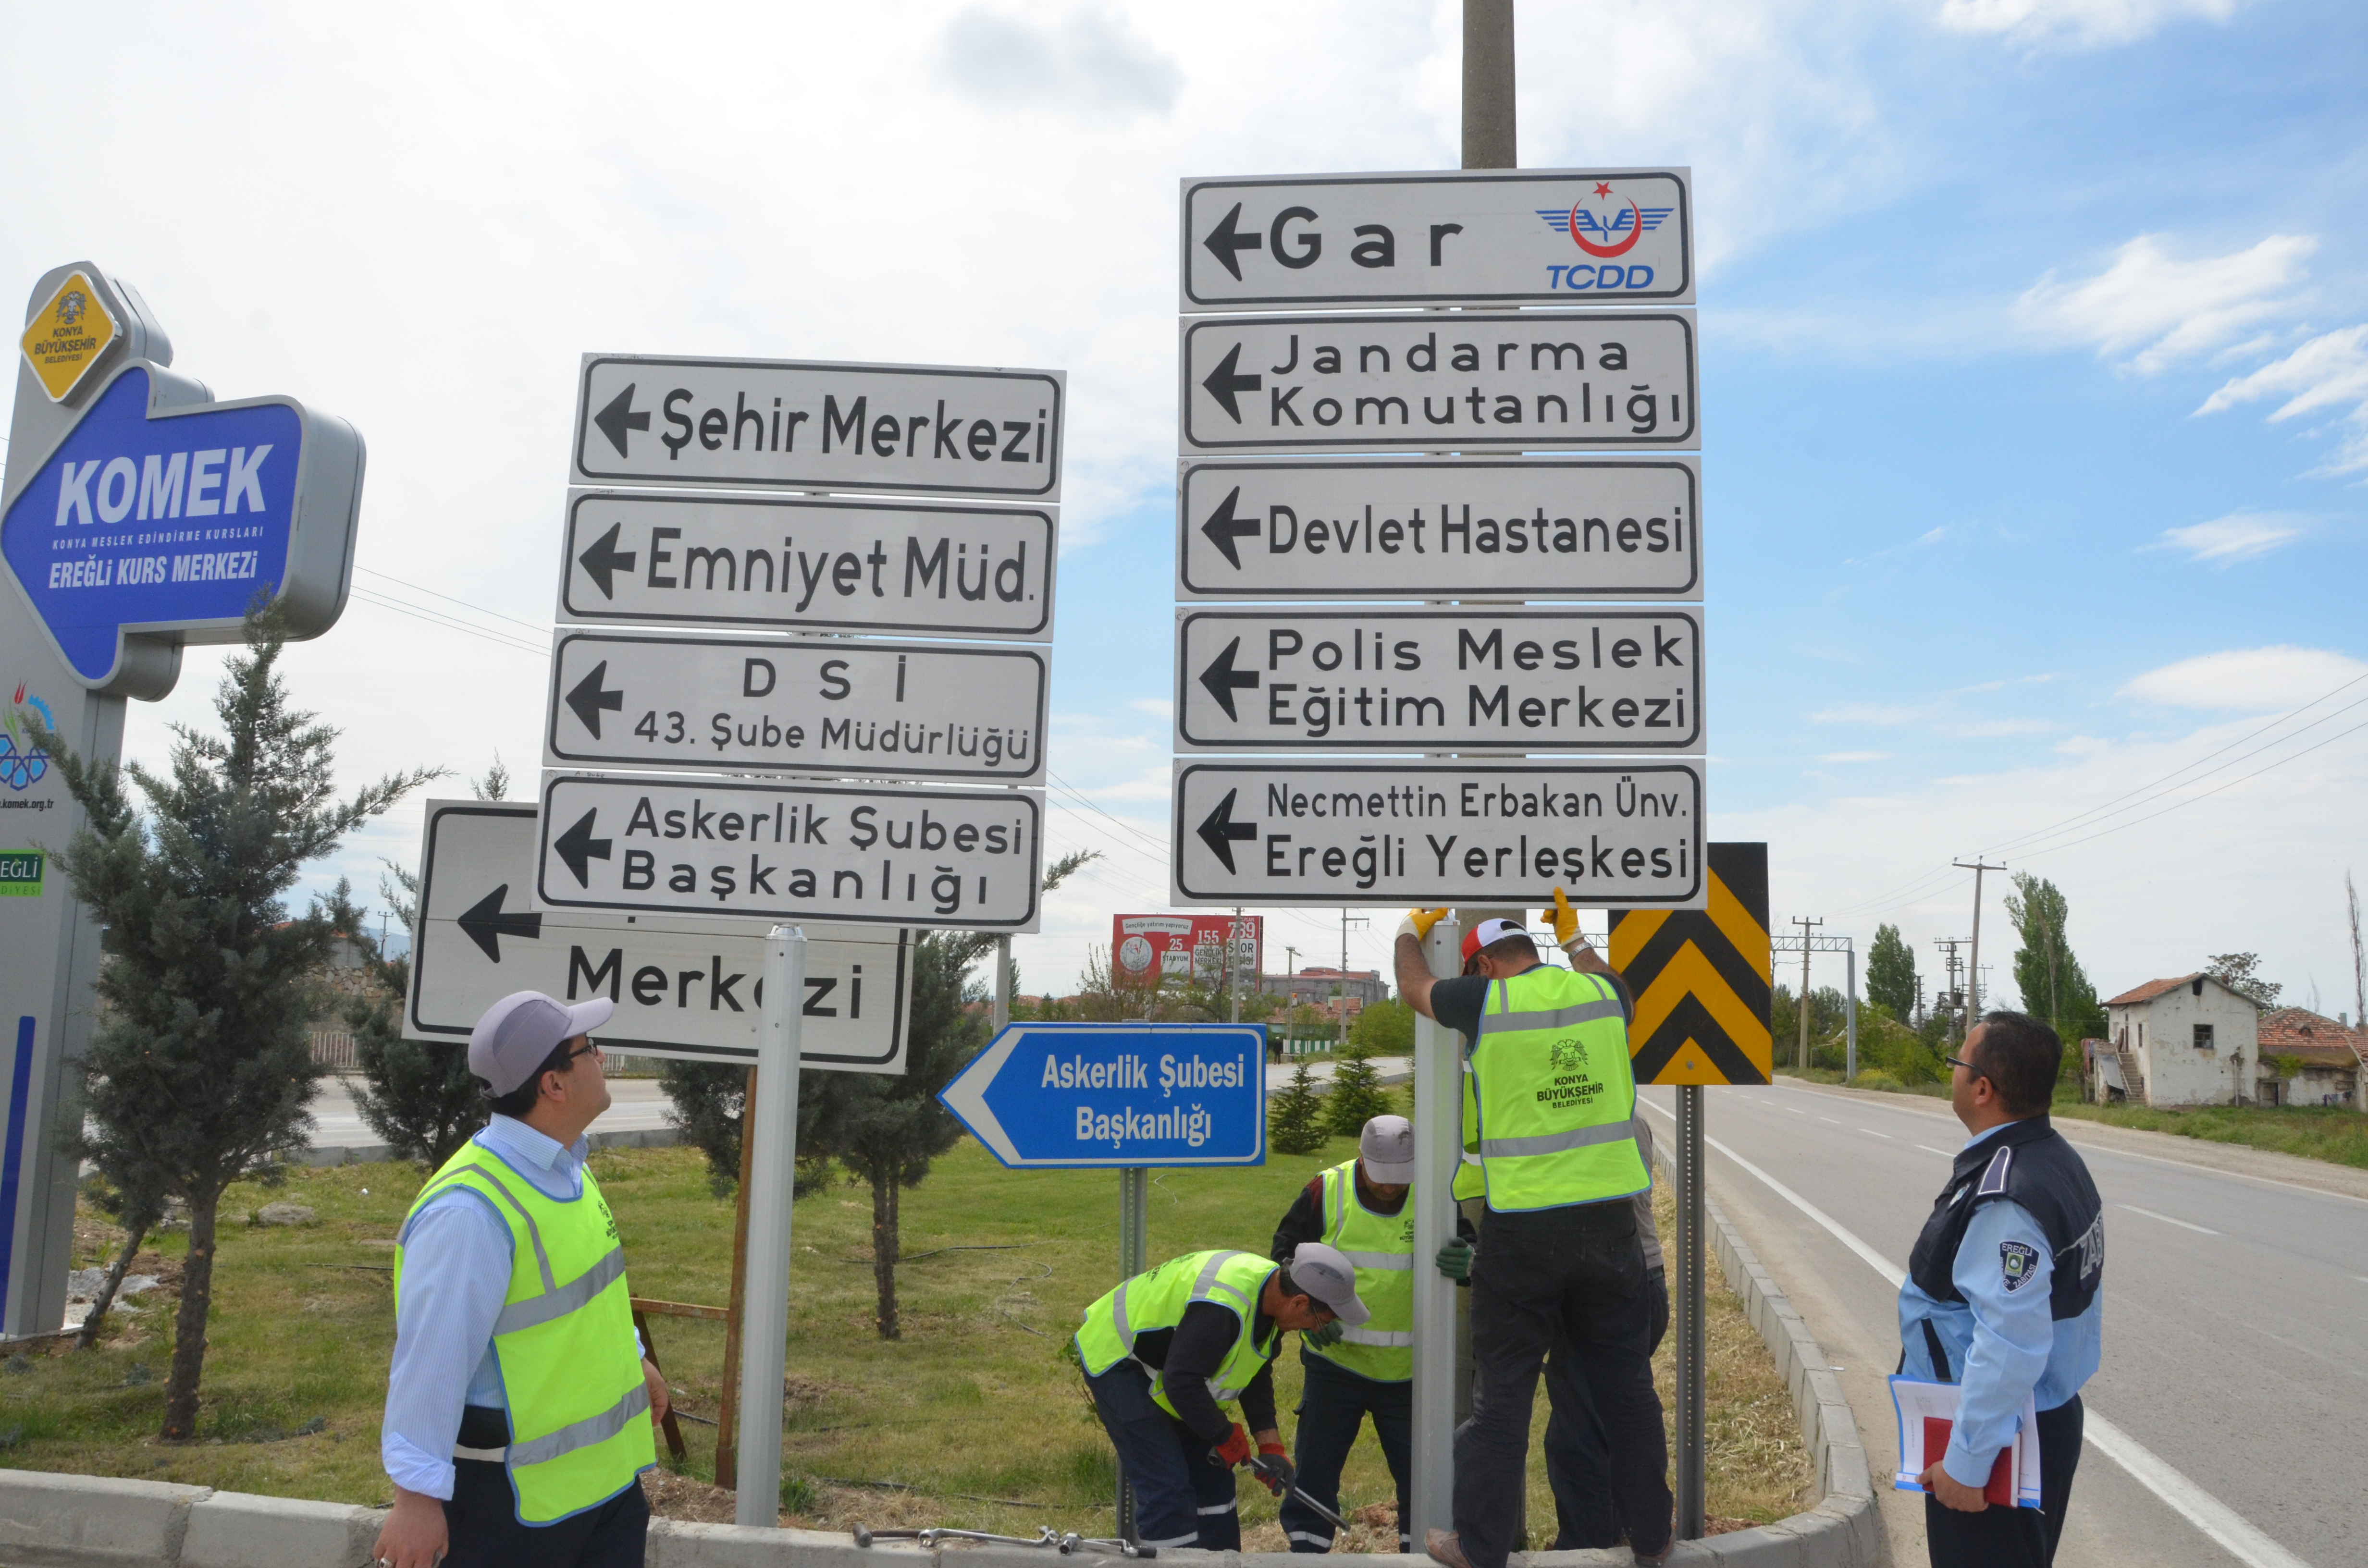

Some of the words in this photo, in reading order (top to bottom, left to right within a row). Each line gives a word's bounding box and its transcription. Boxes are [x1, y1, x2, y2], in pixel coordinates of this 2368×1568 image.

[1270, 206, 1464, 270] Gar
[1546, 264, 1654, 290] TCDD
[34, 335, 97, 355] BÜYÜKŞEHİR
[52, 326, 83, 338] KONYA
[1270, 332, 1628, 375] Jandarma
[45, 352, 83, 364] BELEDİYESİ
[661, 388, 810, 460] Şehir
[822, 394, 1046, 463] Merkezi
[1271, 382, 1680, 434] Komutanlığı
[55, 444, 273, 527] KOMEK
[53, 538, 86, 550] KONYA
[92, 535, 133, 547] MESLEK
[139, 530, 200, 544] EDİNDİRME
[206, 527, 263, 540] KURSLARI
[1270, 504, 1426, 554] Devlet
[1441, 504, 1682, 554] Hastanesi
[49, 554, 112, 588] EREĞLİ
[117, 556, 167, 585] KURS
[172, 551, 258, 582] MERKEZİ
[647, 527, 887, 613] Emniyet
[904, 536, 1034, 603] Müd.
[1269, 628, 1421, 672] Polis
[1458, 625, 1684, 671] Meslek
[1269, 683, 1444, 738] Eğitim
[1469, 685, 1684, 728] Merkezi
[634, 710, 695, 744] 43.
[711, 712, 804, 751] Şube
[821, 717, 1028, 767] Müdürlüğü
[0, 799, 54, 812] .komek.org.tr
[1268, 783, 1446, 818] Necmettin
[1461, 783, 1602, 818] Erbakan
[1616, 775, 1686, 818] Ünv.
[625, 796, 829, 845] Askerlik
[849, 806, 1022, 855] Şubesi
[622, 849, 987, 915] Başkanlığı
[1267, 834, 1404, 889] Ereğli
[1425, 834, 1686, 885] Yerleşkesi
[1169, 938, 1183, 951] 25
[1197, 930, 1219, 944] 155
[1228, 943, 1254, 954] SOR
[567, 945, 862, 1019] Merkzi
[1041, 1054, 1148, 1089] Askerlik
[1159, 1054, 1244, 1098] Şubesi
[1537, 1081, 1604, 1102] BÜYÜKŞEHİR
[1554, 1074, 1589, 1086] KONYA
[1552, 1096, 1593, 1109] BELEDİYESİ
[1076, 1103, 1211, 1149] Başkanlığı
